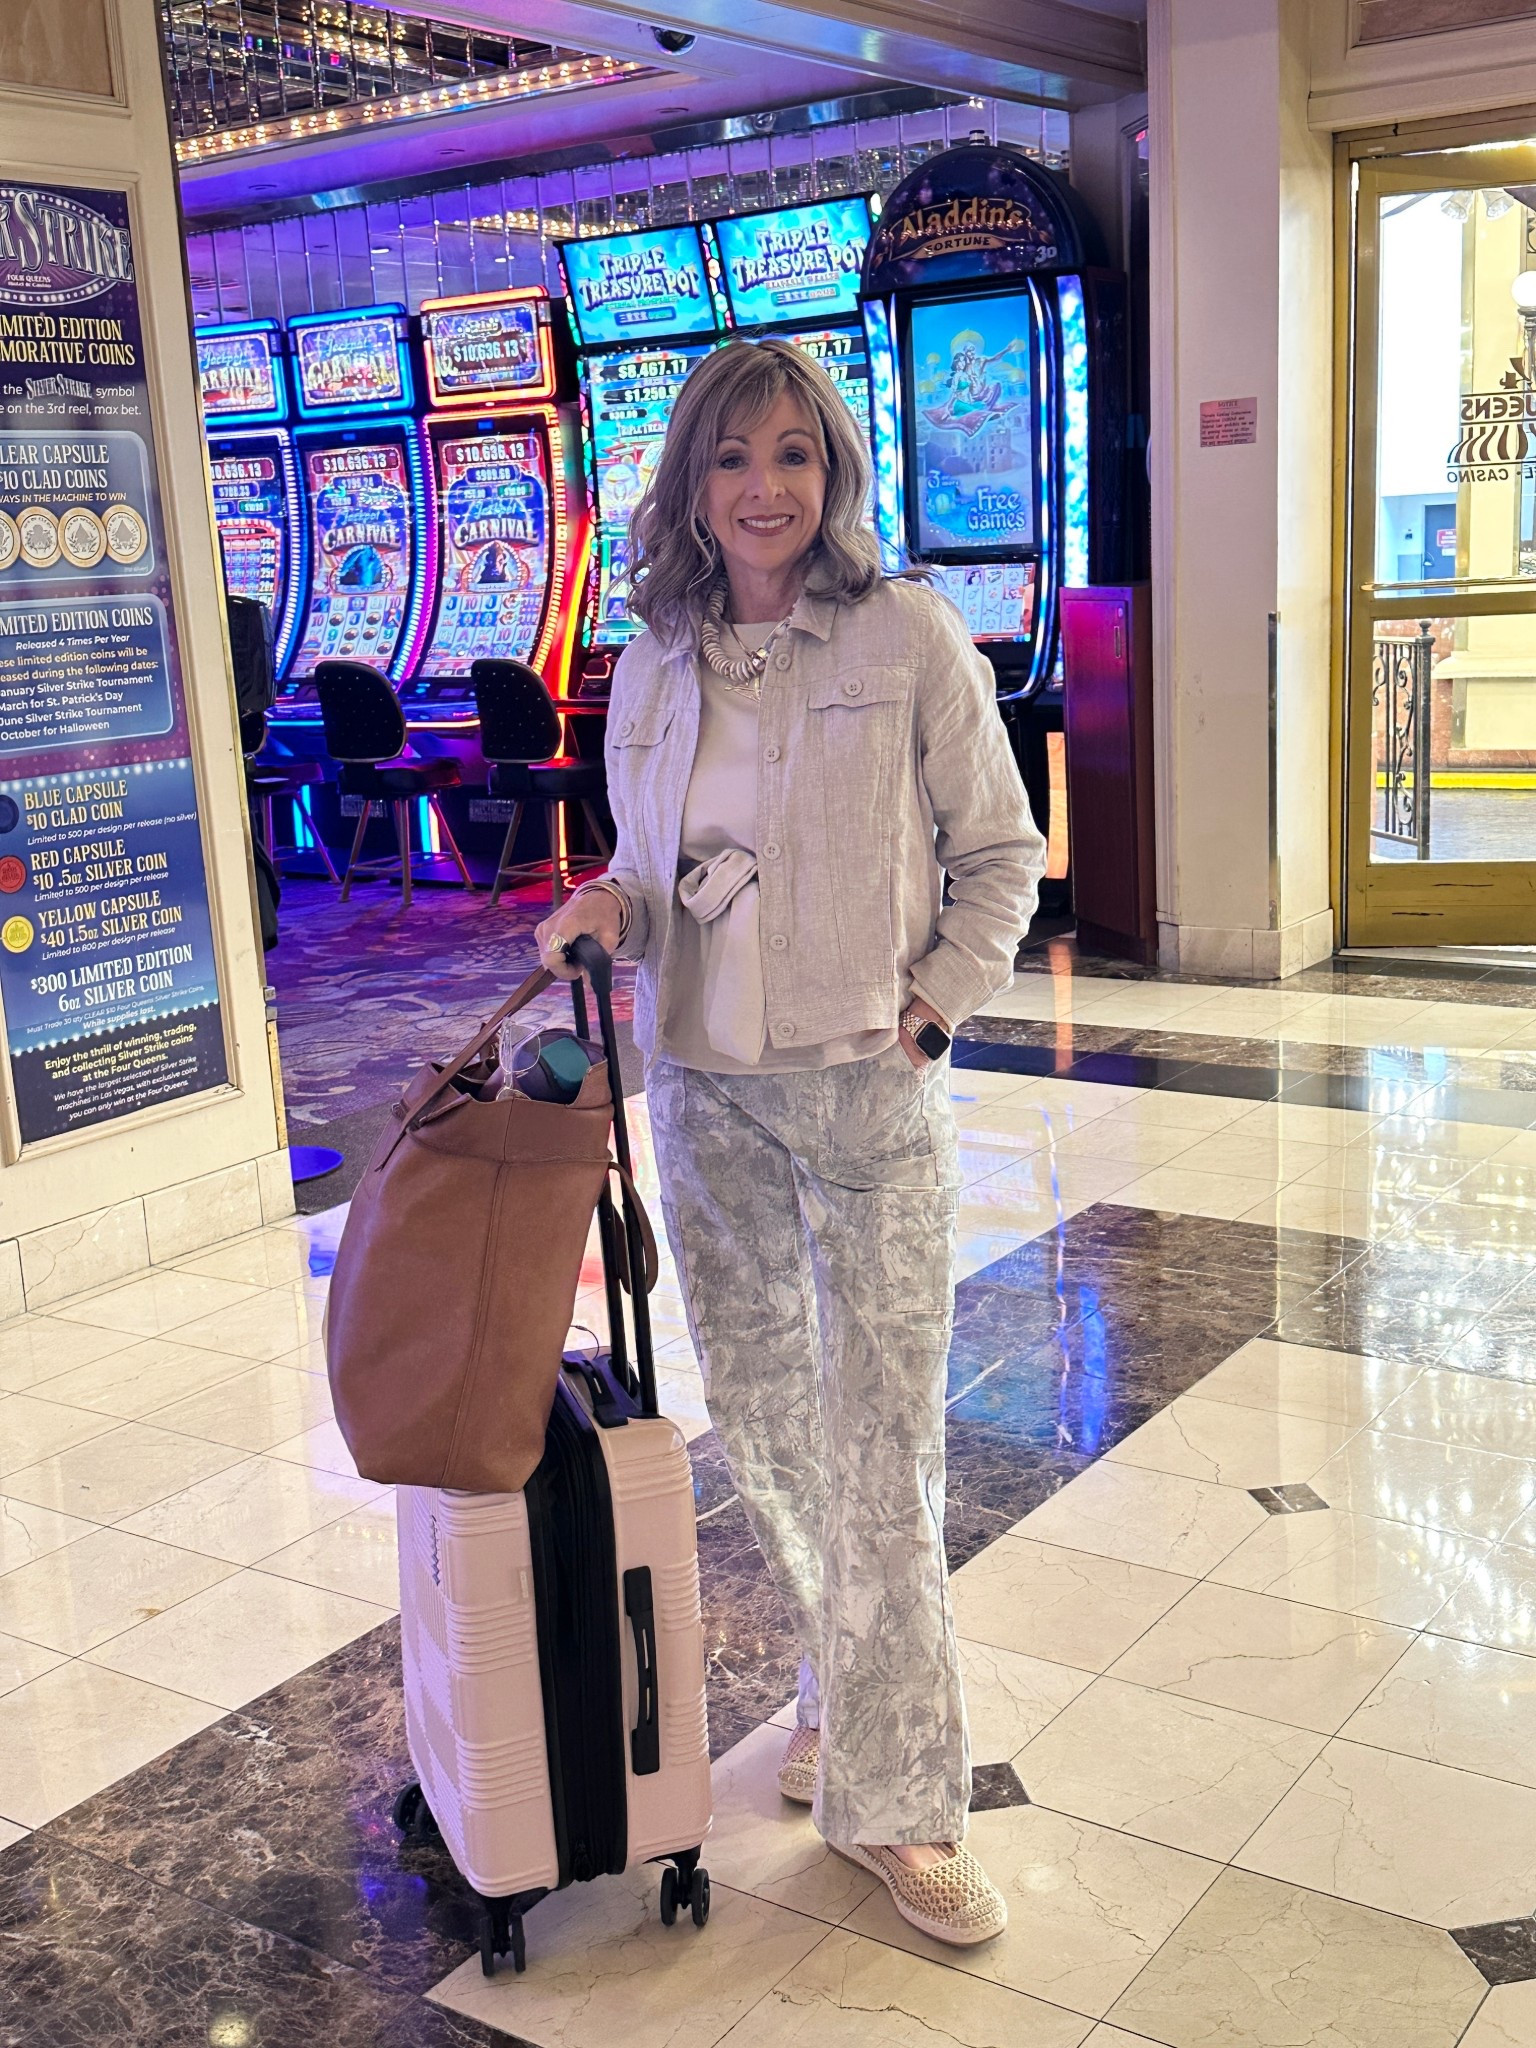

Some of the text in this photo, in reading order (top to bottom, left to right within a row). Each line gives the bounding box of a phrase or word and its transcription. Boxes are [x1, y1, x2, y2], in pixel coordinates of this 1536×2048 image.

[902, 197, 1023, 237] Aladdin's
[756, 219, 831, 257] TRIPLE
[926, 235, 991, 253] FORTUNE
[598, 246, 666, 279] TRIPLE
[731, 237, 866, 292] TREASURE POT
[1035, 245, 1057, 263] 3D
[577, 273, 664, 311] TREASURE
[663, 263, 700, 299] POT
[59, 317, 122, 340] EDITION
[0, 340, 135, 365] MORATIVE COINS
[618, 359, 688, 379] $8,467.17
[4, 384, 22, 394] the
[96, 386, 135, 398] symbol
[8, 404, 22, 413] on
[26, 403, 44, 413] the
[47, 403, 65, 413] 3rd
[69, 403, 91, 415] reel,
[95, 406, 118, 414] max
[121, 405, 141, 415] bet.
[0, 445, 110, 464] LEAR CAPSULE
[22, 469, 61, 489] CLAD
[65, 469, 108, 488] COINS
[928, 471, 940, 488] 3
[22, 494, 31, 503] IN
[34, 494, 51, 502] THE
[53, 493, 93, 501] MACHINE
[109, 492, 127, 500] WIN
[977, 487, 1020, 511] Free
[454, 518, 539, 547] CARNIVAL
[968, 508, 1025, 530] Games
[323, 523, 401, 552] CARNIVAL
[0, 607, 153, 636] MITED EDITION COINS
[16, 634, 130, 650] Released 4 Times Per Year
[17, 654, 52, 665] limited
[55, 651, 88, 662] edition
[91, 649, 116, 659] coins
[117, 647, 134, 657] will
[136, 647, 148, 656] be
[0, 661, 158, 682] eased during the following dates:
[37, 683, 64, 694] Silver
[66, 680, 94, 691] Strike
[96, 674, 153, 688] Tournament
[30, 698, 45, 707] for
[46, 698, 61, 707] St.
[62, 692, 103, 705] Patrick's
[105, 691, 123, 702] Day
[0, 703, 143, 726] June Silver Strike Tournament
[1, 721, 110, 741] October for Halloween
[24, 780, 128, 811] BLUE CAPSULE
[27, 800, 124, 831] $10 CLAD COIN
[27, 835, 57, 846] Limited
[58, 832, 67, 840] to
[67, 829, 83, 838] 500
[83, 828, 97, 838] per
[97, 824, 123, 836] design
[123, 822, 136, 832] per
[137, 818, 163, 828] release
[176, 811, 197, 822] silver)
[30, 838, 126, 871] RED CAPSULE
[33, 872, 54, 891] $10
[85, 858, 134, 882] SILVER
[136, 852, 168, 873] COIN
[38, 890, 161, 929] YELLOW CAPSULE
[40, 930, 65, 948] $40
[101, 912, 149, 937] SILVER
[151, 906, 183, 927] COIN
[30, 944, 193, 995] $300 LIMITED EDITION
[83, 978, 137, 1007] SILVER
[139, 969, 174, 993] COIN
[82, 1018, 106, 1030] While
[106, 1010, 139, 1024] supplies
[44, 1023, 197, 1070] Enjoy the thrill of winning, trading,
[52, 1034, 194, 1079] and collecting Silver Strike coins
[82, 1053, 168, 1083] at the Four Queens.
[68, 1110, 83, 1122] you
[83, 1107, 97, 1116] can
[97, 1102, 113, 1113] only
[113, 1098, 126, 1106] win
[135, 1092, 147, 1100] the
[147, 1087, 163, 1097] Four
